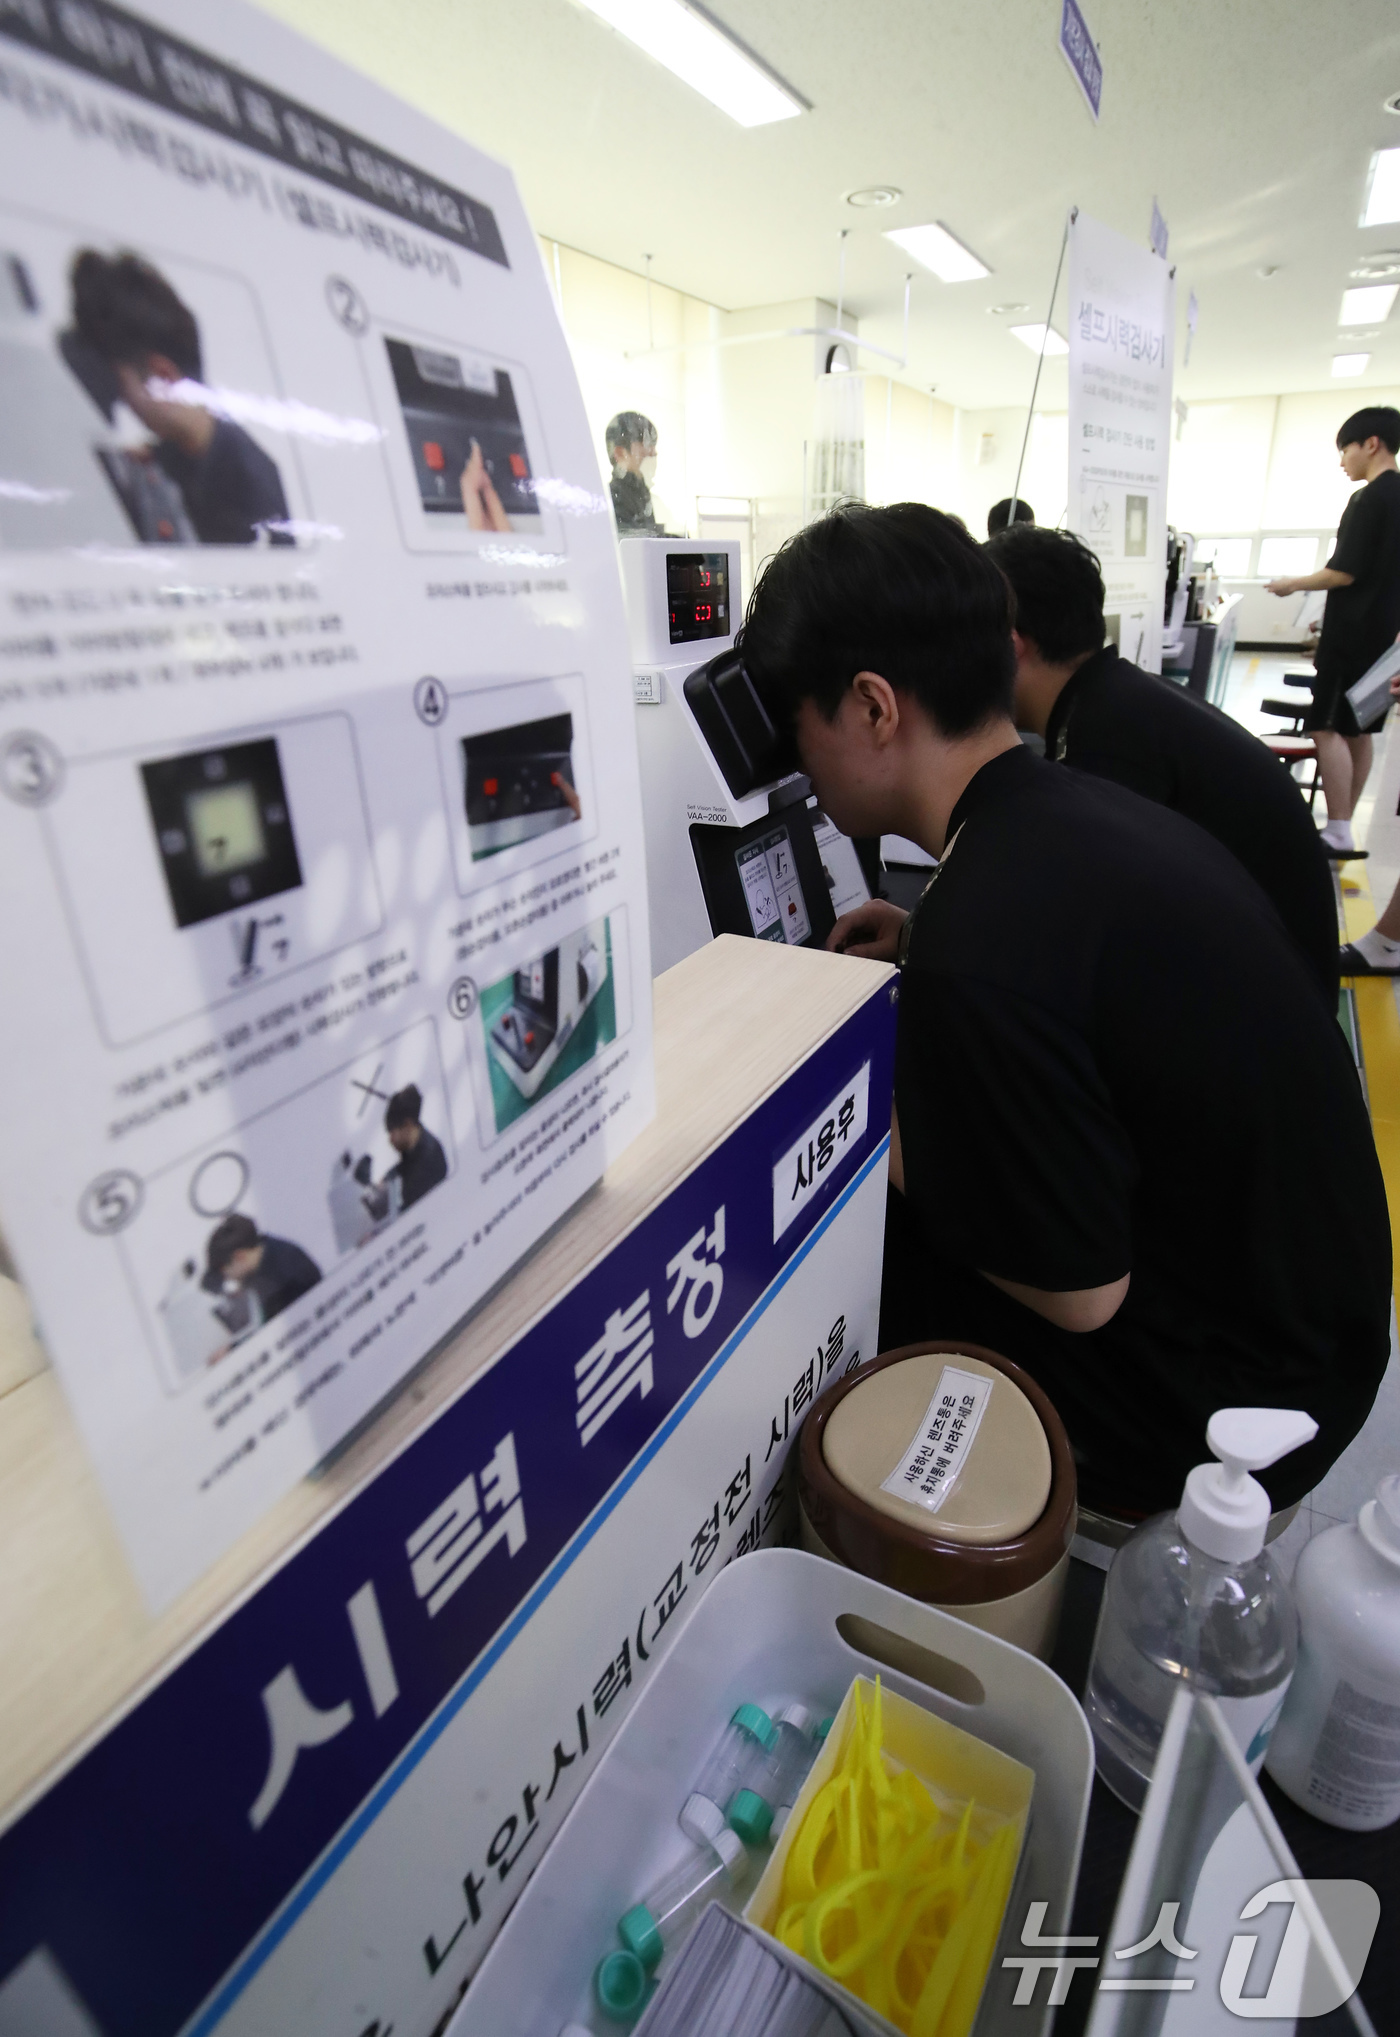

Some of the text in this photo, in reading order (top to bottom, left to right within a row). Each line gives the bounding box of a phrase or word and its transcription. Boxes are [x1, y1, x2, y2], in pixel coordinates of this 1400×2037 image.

[1078, 300, 1165, 370] 셀프시력검사기
[687, 812, 727, 823] VAA-2000
[792, 1094, 855, 1201] 사용후
[903, 1395, 957, 1483] 사용하신 렌즈통은
[920, 1395, 976, 1495] 휴지통에 버려주세요
[248, 1431, 527, 1831] 시력
[574, 1204, 727, 1448] 측정
[423, 1454, 752, 1978] 나안시력(교정전
[764, 1315, 847, 1463] 시력)을
